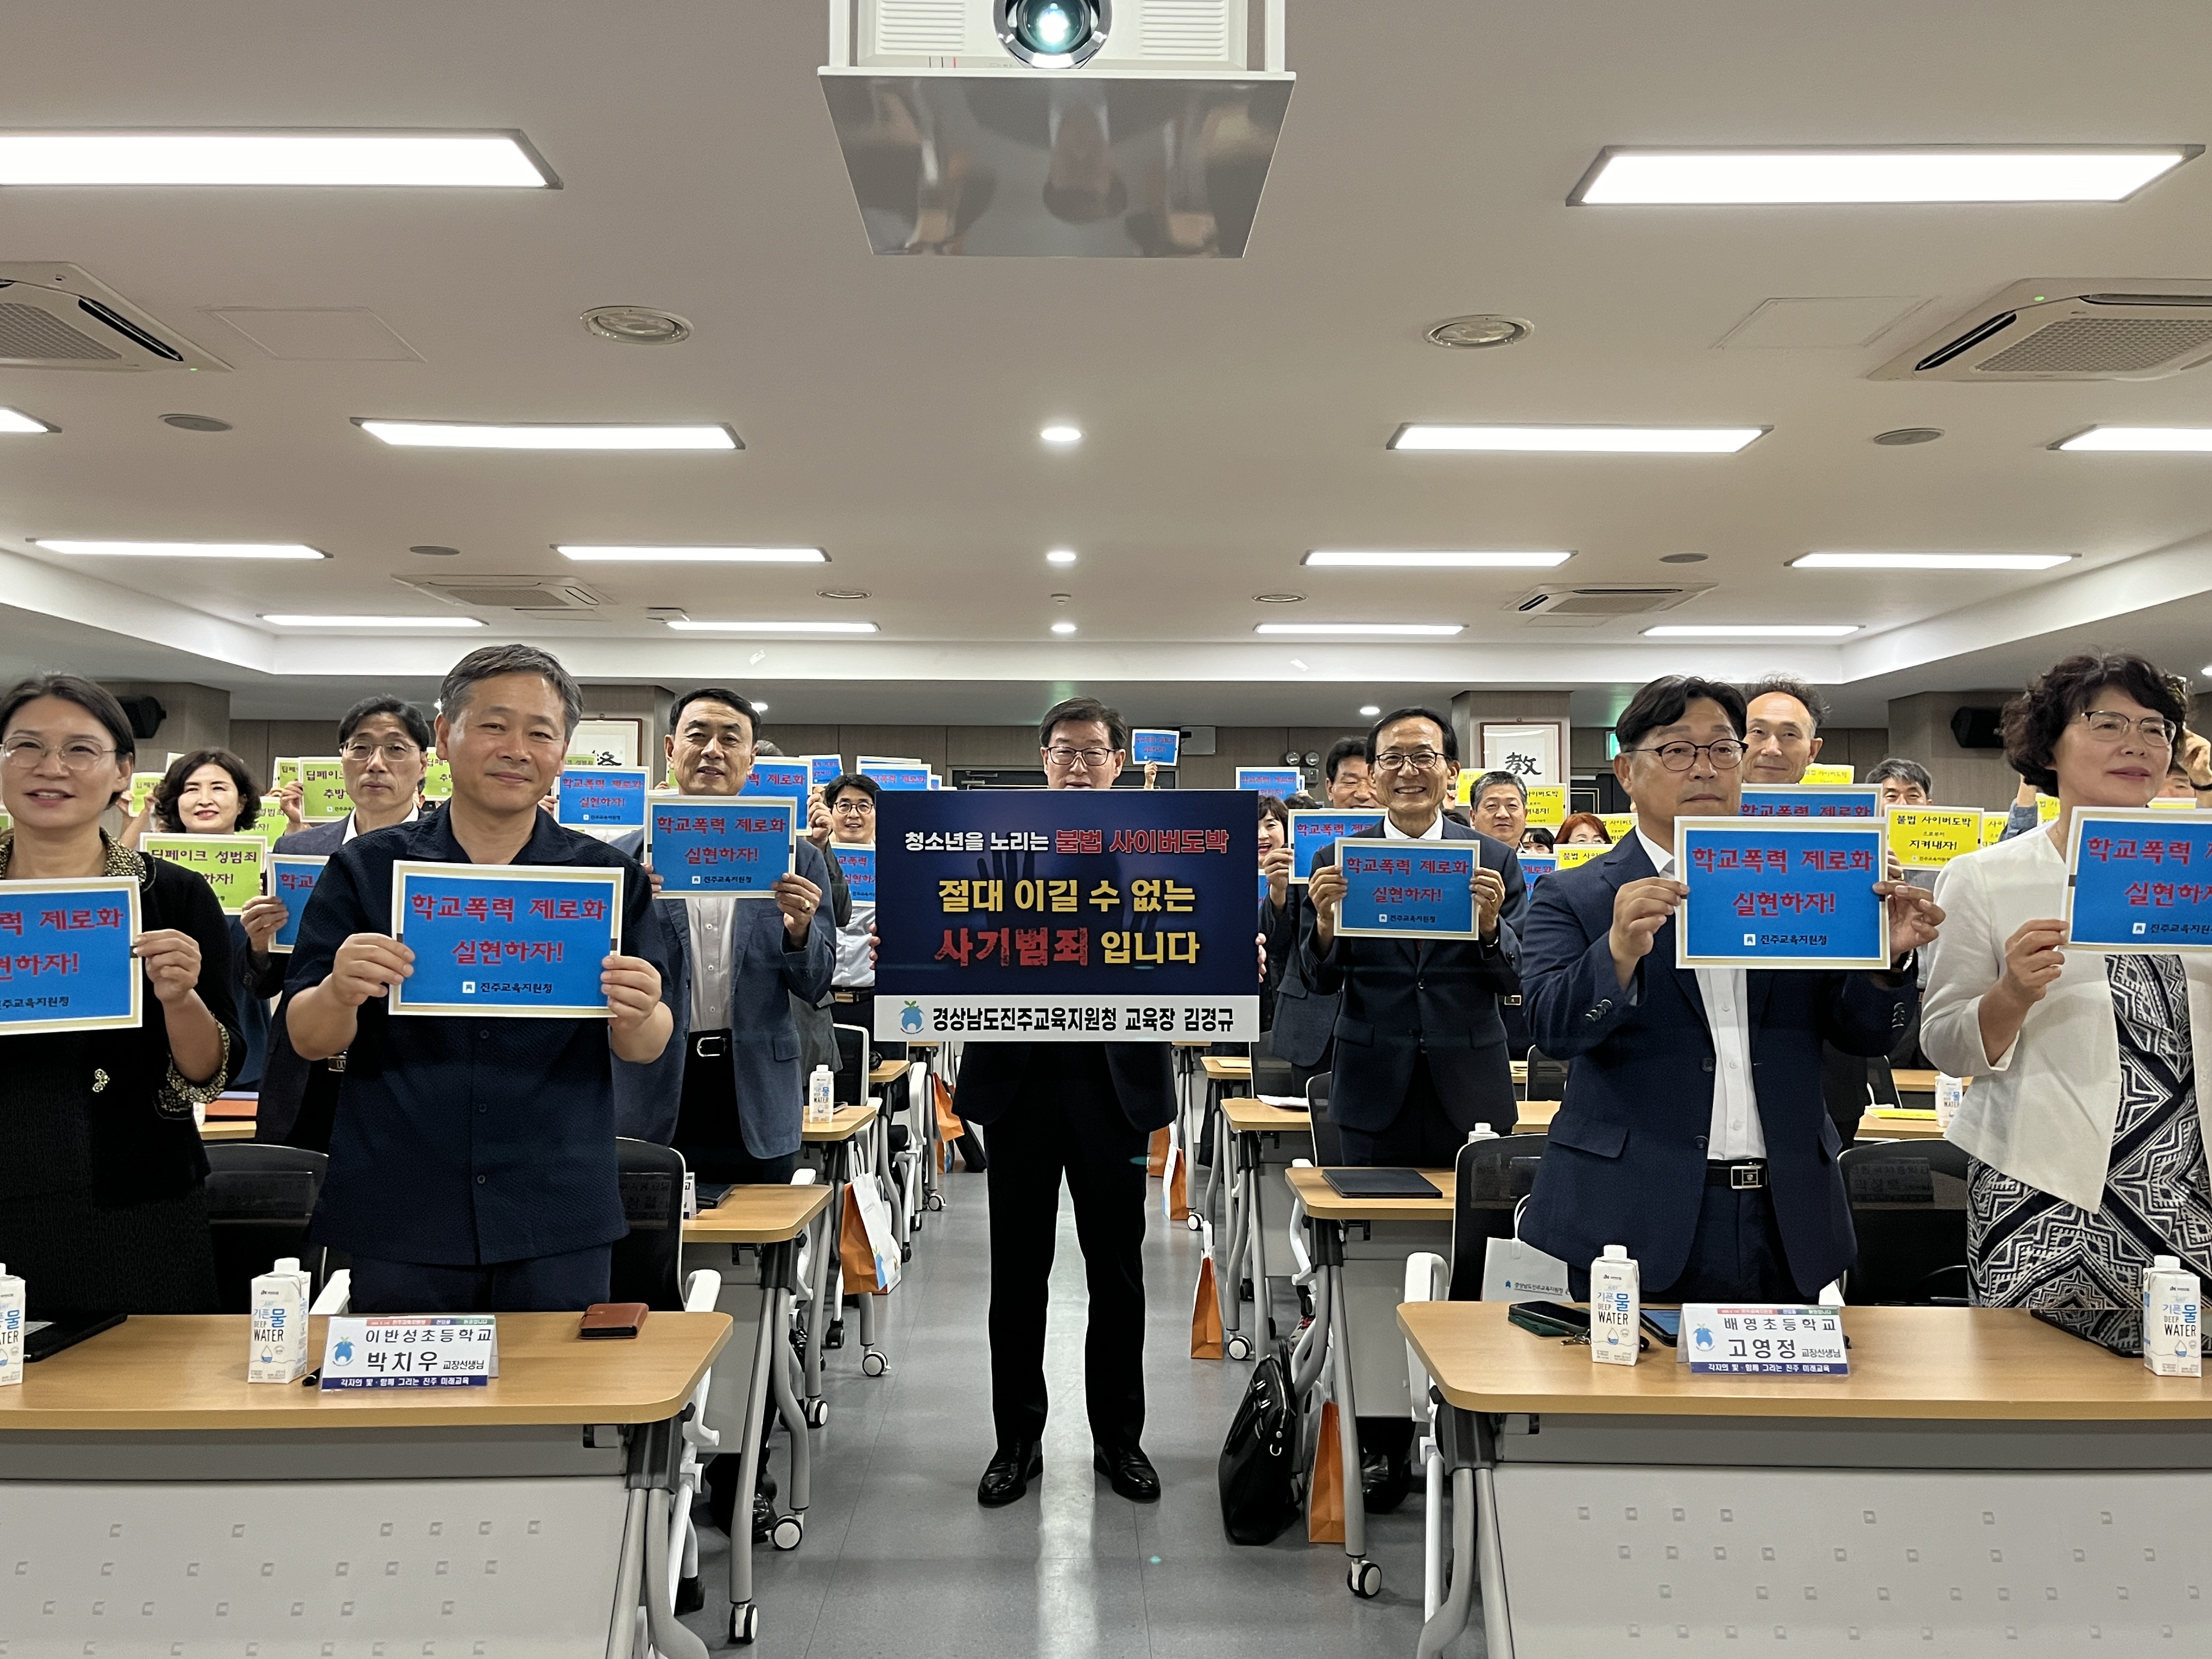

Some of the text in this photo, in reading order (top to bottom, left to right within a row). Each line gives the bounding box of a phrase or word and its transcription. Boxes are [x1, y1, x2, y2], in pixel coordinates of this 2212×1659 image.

[767, 773, 805, 786] 제로화
[657, 816, 786, 835] 학교폭력 제로화
[1921, 816, 1972, 827] 사이버도박
[1296, 823, 1344, 836] 학교폭력
[904, 828, 1229, 855] 청소년을 노리는 불법 사이버도박
[1909, 840, 1957, 850] 지켜내자!
[215, 850, 257, 864] 성범죄
[685, 848, 758, 865] 실현하자!
[2087, 837, 2191, 865] 학교폭력
[838, 856, 867, 867] 교폭력
[1347, 857, 1470, 876] 학교폭력 제로화
[1692, 848, 1874, 874] 학교폭력 제로화
[703, 876, 752, 884] 진주교육지원청
[939, 879, 1196, 913] 절대 이길 수 없는
[1372, 887, 1442, 904] 실현하자!
[2125, 882, 2212, 907] 실현하
[411, 894, 607, 923] 학교폭력 제로화
[1733, 891, 1835, 917] 실현하자!
[40, 907, 124, 930] 제로화
[2151, 924, 2212, 934] 진주교육지원
[1760, 934, 1827, 946] 진주교육지원청
[452, 939, 563, 965] 실현하자!
[934, 927, 1200, 968] 사기범죄 입니다
[480, 982, 552, 994] 진주교육지원청
[932, 1008, 1234, 1032] 경상남도진주교육지원청 교육장 김경규
[1598, 1303, 1611, 1311] DEEP
[254, 1320, 267, 1328] DEEP
[1598, 1311, 1628, 1325] WATER
[1724, 1318, 1836, 1331] 배영초등학교
[254, 1329, 284, 1342] WATER
[365, 1329, 492, 1343] 이반성초등학교
[2164, 1323, 2196, 1337] WATER
[0, 1330, 19, 1345] TER
[1728, 1339, 1841, 1359] 고영정 교장선생님
[368, 1351, 484, 1372] 박치우 교장선생님
[1763, 1364, 1782, 1372] 그리는
[398, 1378, 420, 1386] 그리는
[423, 1378, 437, 1386] 진주
[441, 1377, 470, 1385] 미래교육
